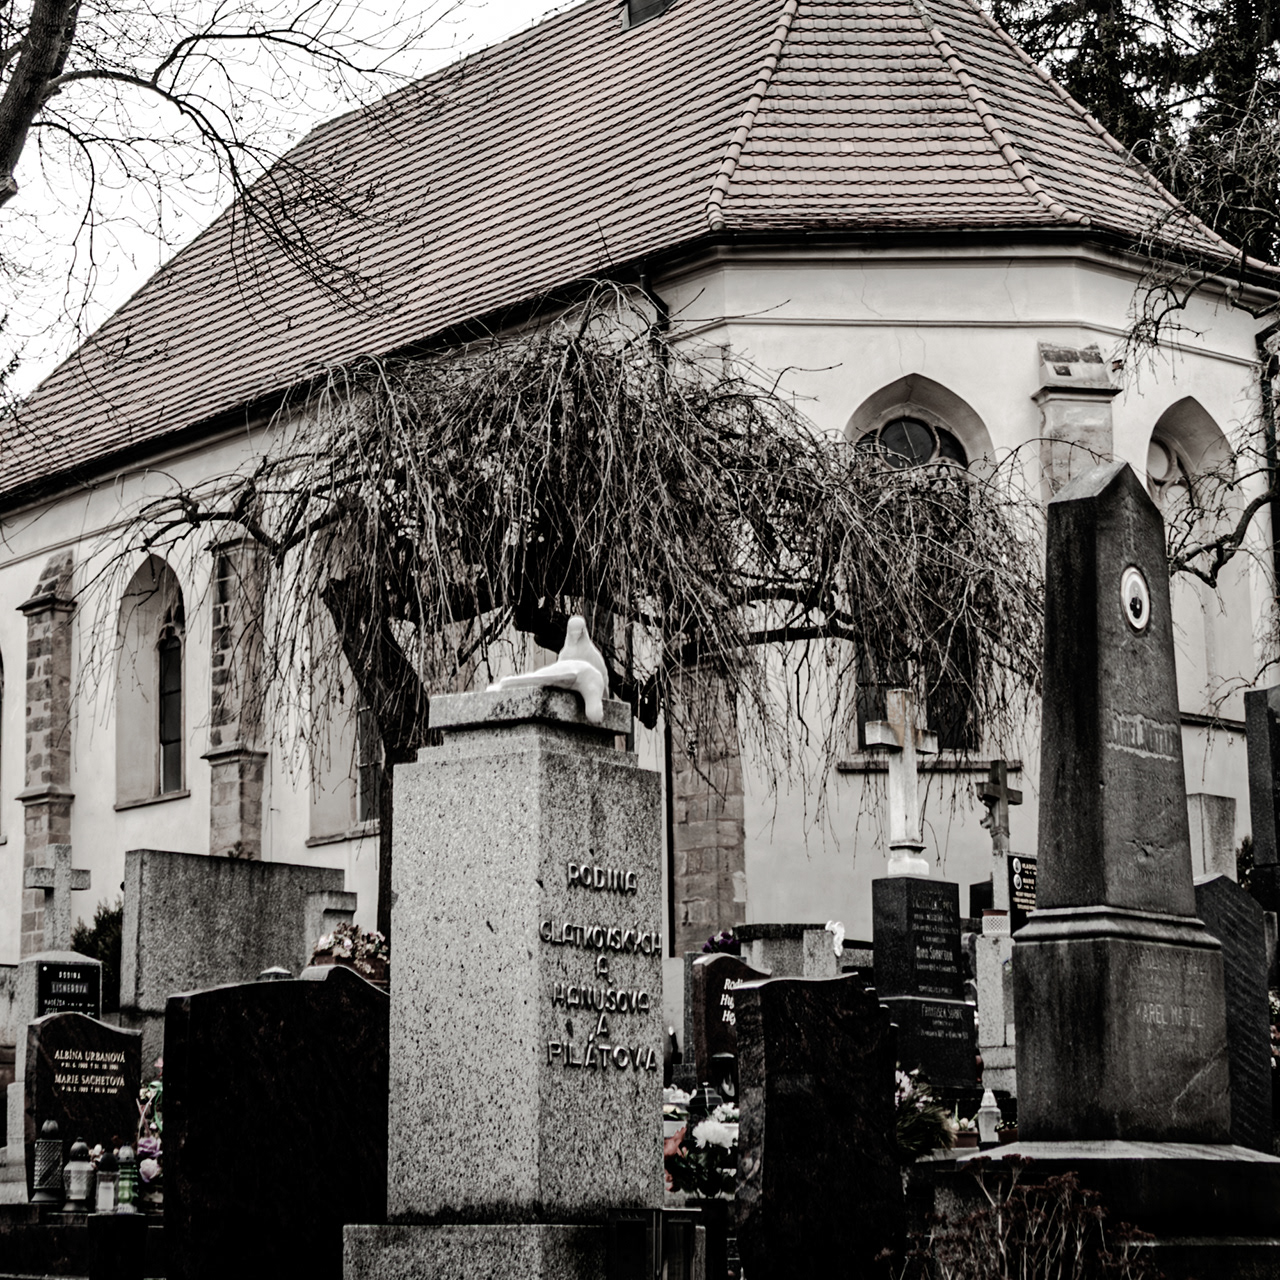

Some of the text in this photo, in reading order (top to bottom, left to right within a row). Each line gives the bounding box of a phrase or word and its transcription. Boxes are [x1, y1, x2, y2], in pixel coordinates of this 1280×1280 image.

[567, 863, 638, 894] RODINA
[596, 954, 608, 976] A
[596, 1014, 608, 1035] A
[85, 1050, 125, 1063] URBANOVÁ
[547, 1033, 657, 1070] PILÁTOVA
[54, 1073, 79, 1084] MARIE
